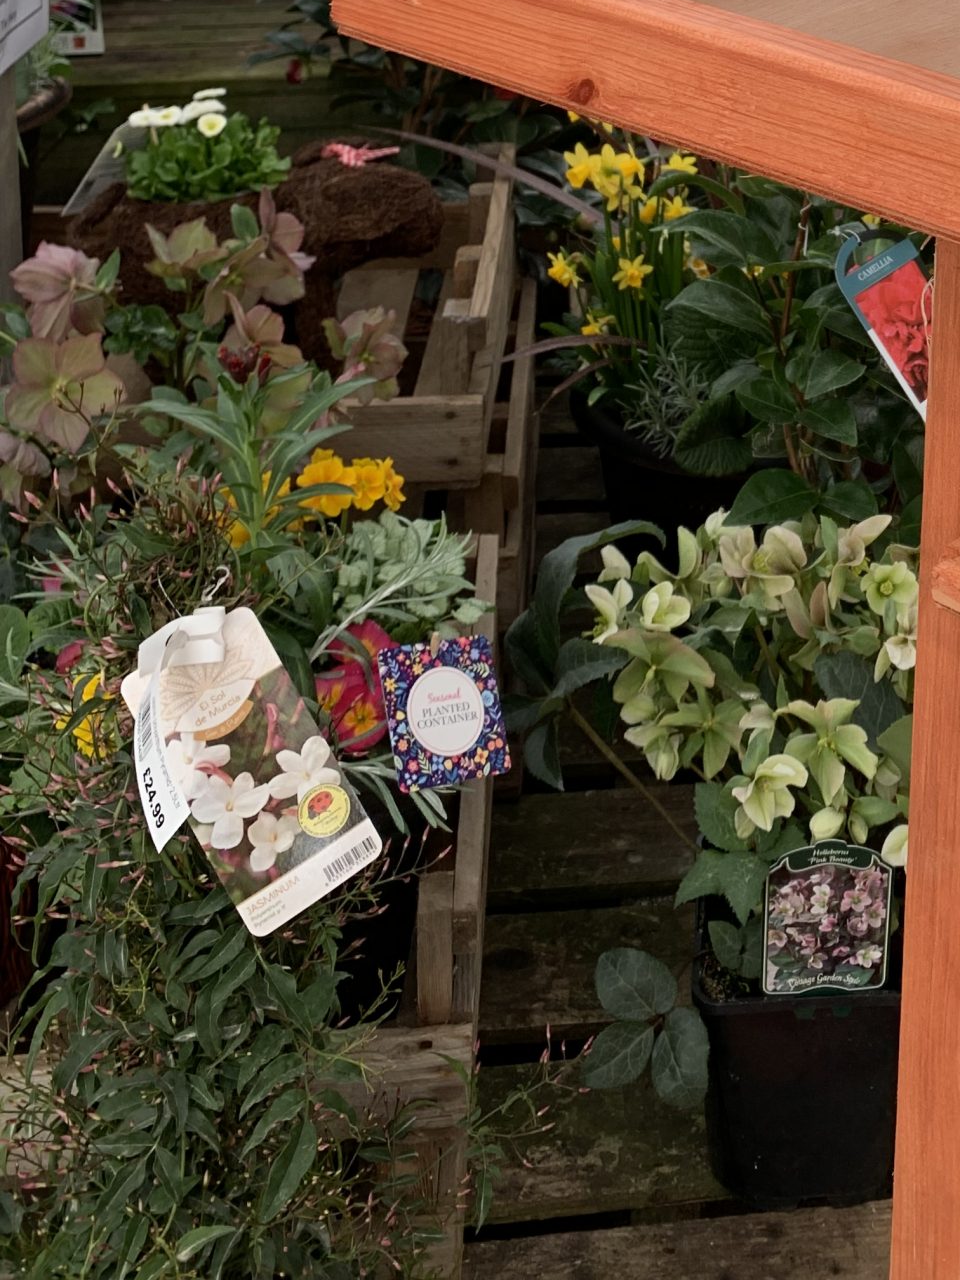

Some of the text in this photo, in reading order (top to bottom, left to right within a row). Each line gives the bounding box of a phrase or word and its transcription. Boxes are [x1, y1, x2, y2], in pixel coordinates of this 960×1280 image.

[857, 255, 894, 281] CAMELLIA
[208, 695, 241, 718] Murcia
[210, 689, 226, 705] Sol
[417, 711, 479, 730] CONTAINER
[422, 701, 470, 719] PLANTED
[142, 767, 166, 829] £24.99
[246, 875, 301, 915] JASMINUM
[816, 972, 843, 984] Garden
